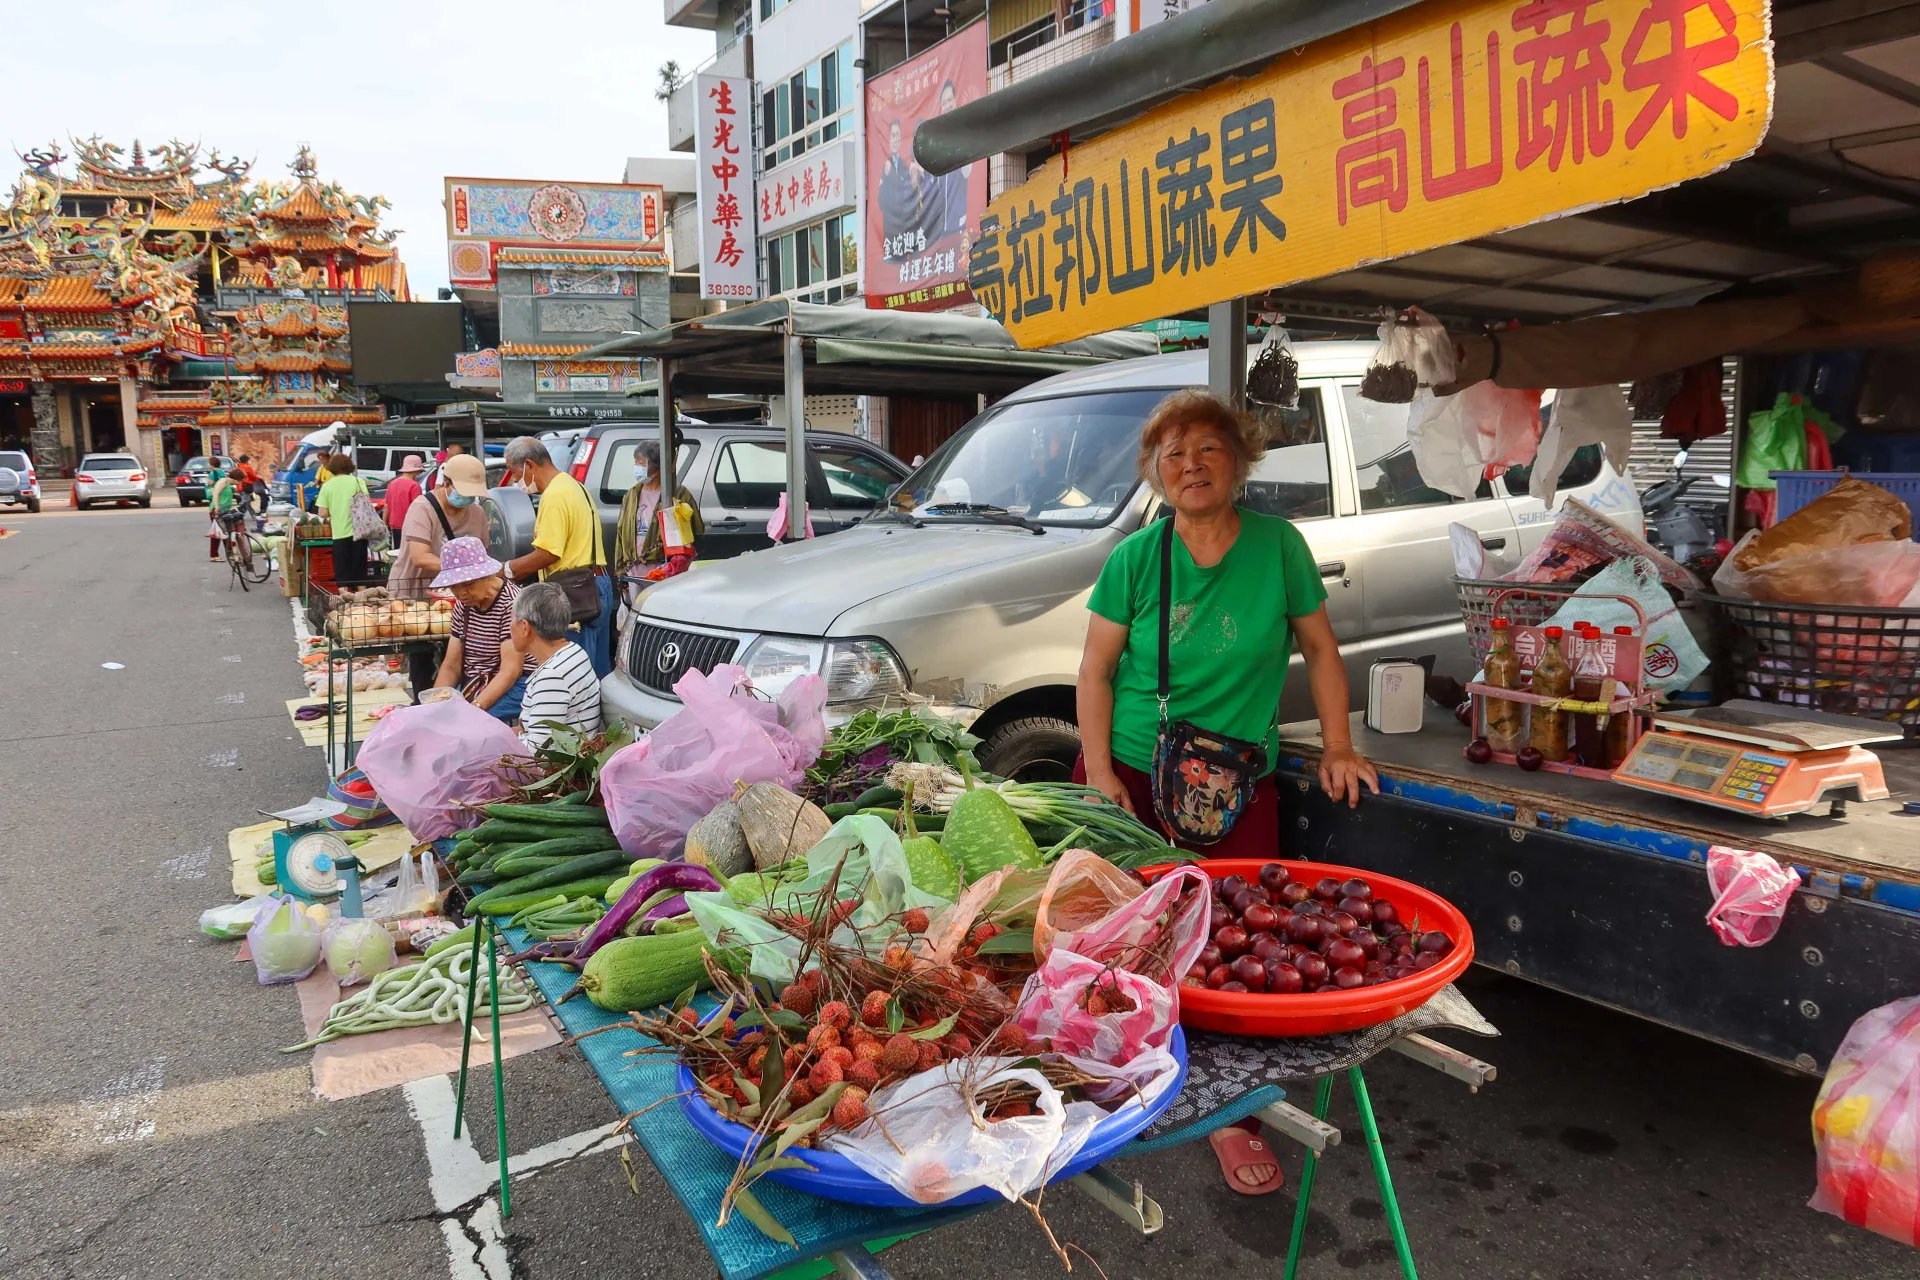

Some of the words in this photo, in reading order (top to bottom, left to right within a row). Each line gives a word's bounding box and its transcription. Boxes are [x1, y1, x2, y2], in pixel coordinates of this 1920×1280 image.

[709, 80, 744, 267] 生光中藥房
[760, 160, 831, 222] 生光中藥房
[969, 98, 1288, 326] 馬拉邦山蔬果
[883, 227, 927, 260] 金蛇迎春
[899, 248, 955, 283] 好運年年增
[708, 284, 753, 296] 380380
[1518, 511, 1551, 524] SURF
